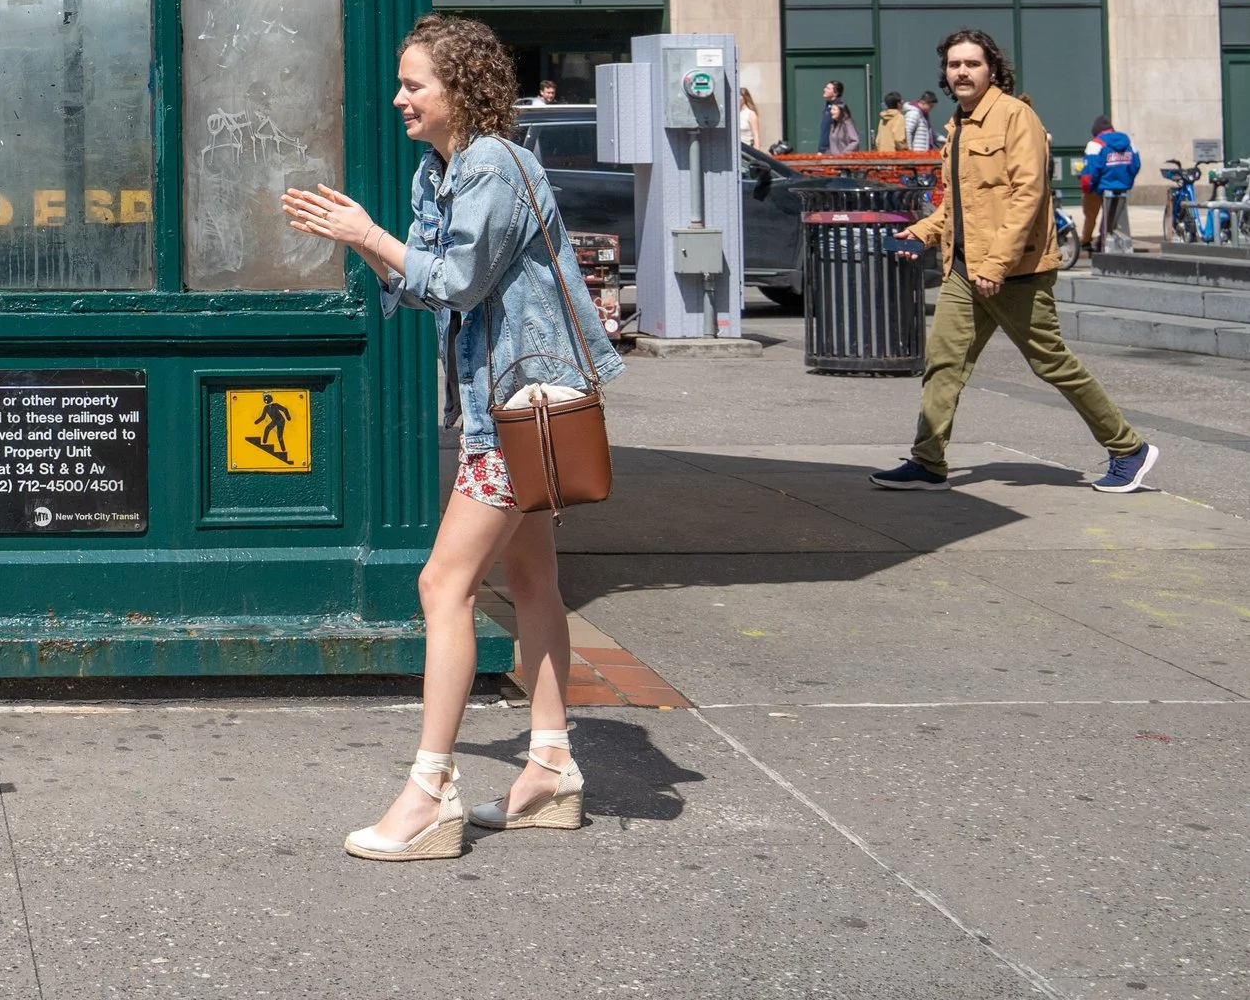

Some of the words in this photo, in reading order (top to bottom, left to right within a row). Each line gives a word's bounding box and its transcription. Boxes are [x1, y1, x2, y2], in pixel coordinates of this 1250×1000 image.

[2, 397, 17, 407] or
[21, 394, 57, 407] other
[61, 395, 119, 408] property
[7, 412, 20, 424] to
[26, 411, 63, 424] these
[68, 411, 114, 426] railings
[119, 411, 140, 423] will
[27, 428, 52, 441] and
[57, 428, 117, 441] delivered
[122, 429, 136, 440] to
[4, 446, 61, 460] Property
[66, 445, 92, 457] Unit
[16, 463, 34, 475] 34
[39, 463, 54, 475] St
[59, 463, 70, 475] &
[75, 463, 85, 474] 8
[90, 463, 106, 475] Av
[17, 479, 124, 493] 712-4500/4501
[55, 513, 74, 521] New
[75, 512, 93, 521] York
[94, 512, 111, 522] City
[111, 512, 140, 521] Transit
